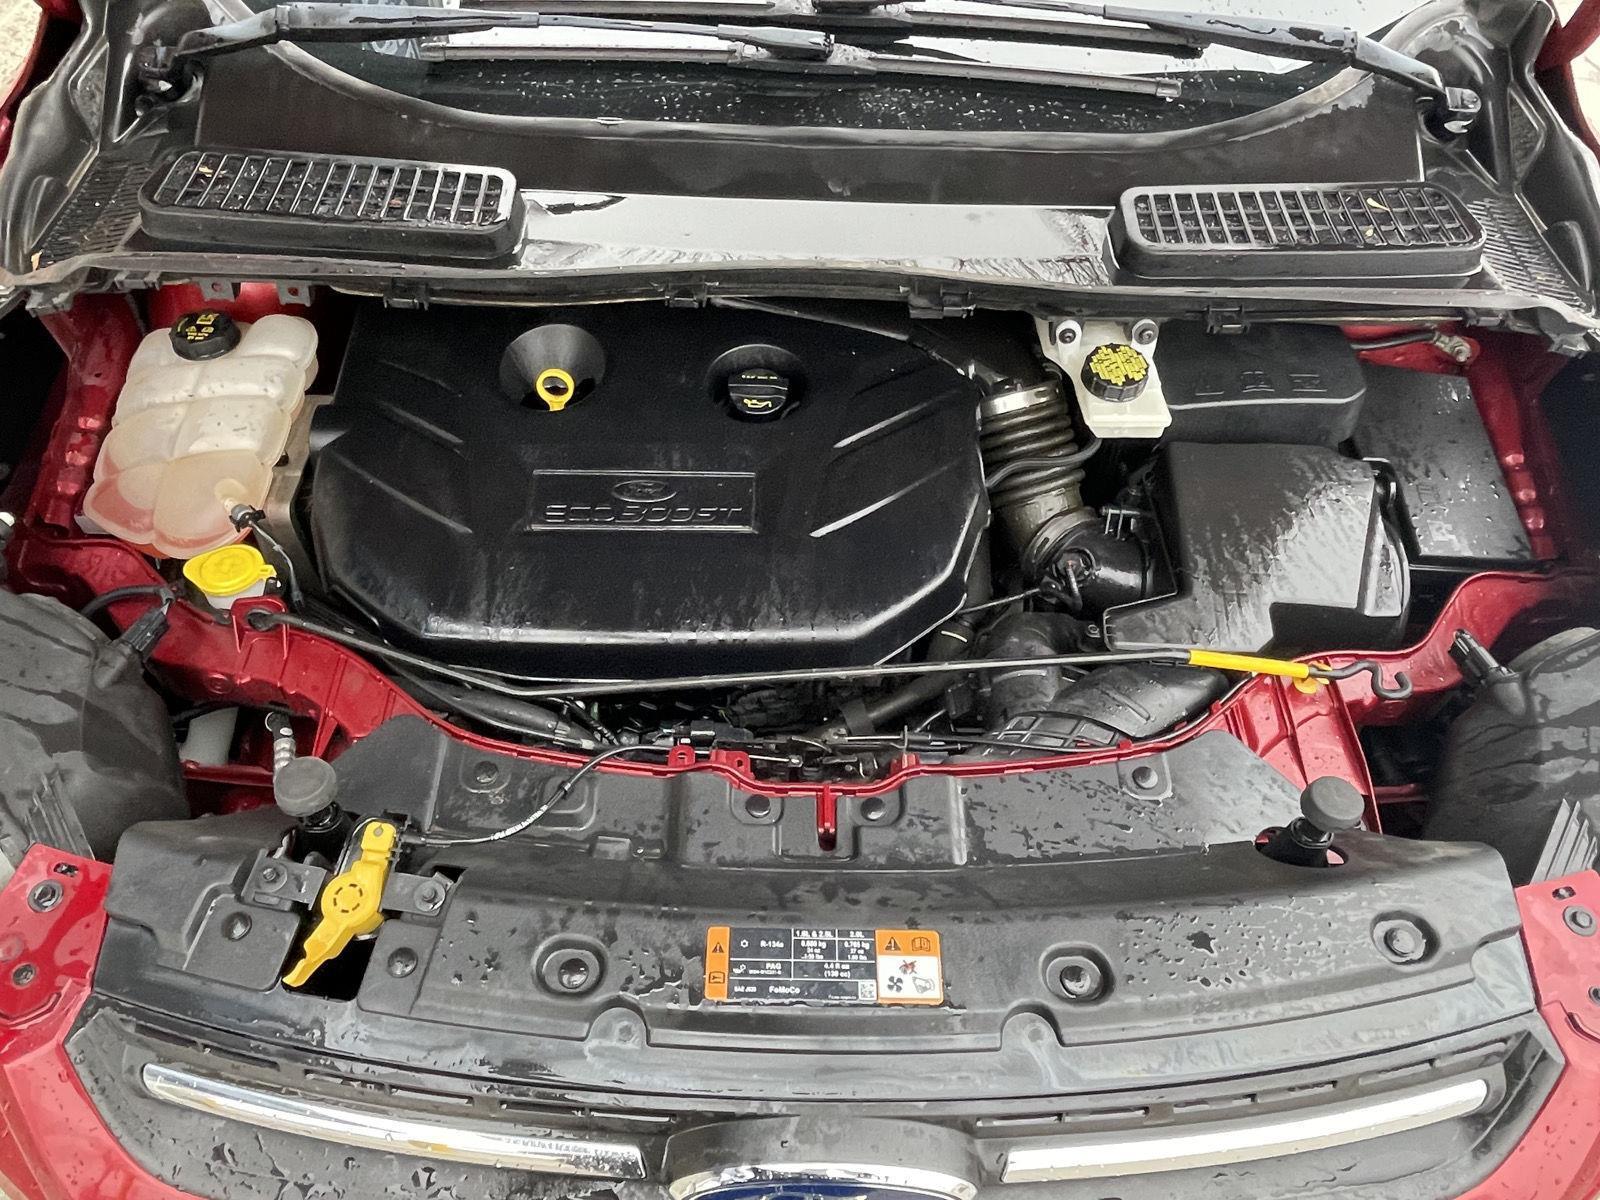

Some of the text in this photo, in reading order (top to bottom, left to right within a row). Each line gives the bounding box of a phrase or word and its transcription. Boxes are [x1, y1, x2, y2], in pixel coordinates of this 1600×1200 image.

[760, 940, 784, 948] R-134a
[765, 962, 782, 970] PAG
[769, 985, 801, 994] FoMoCo
